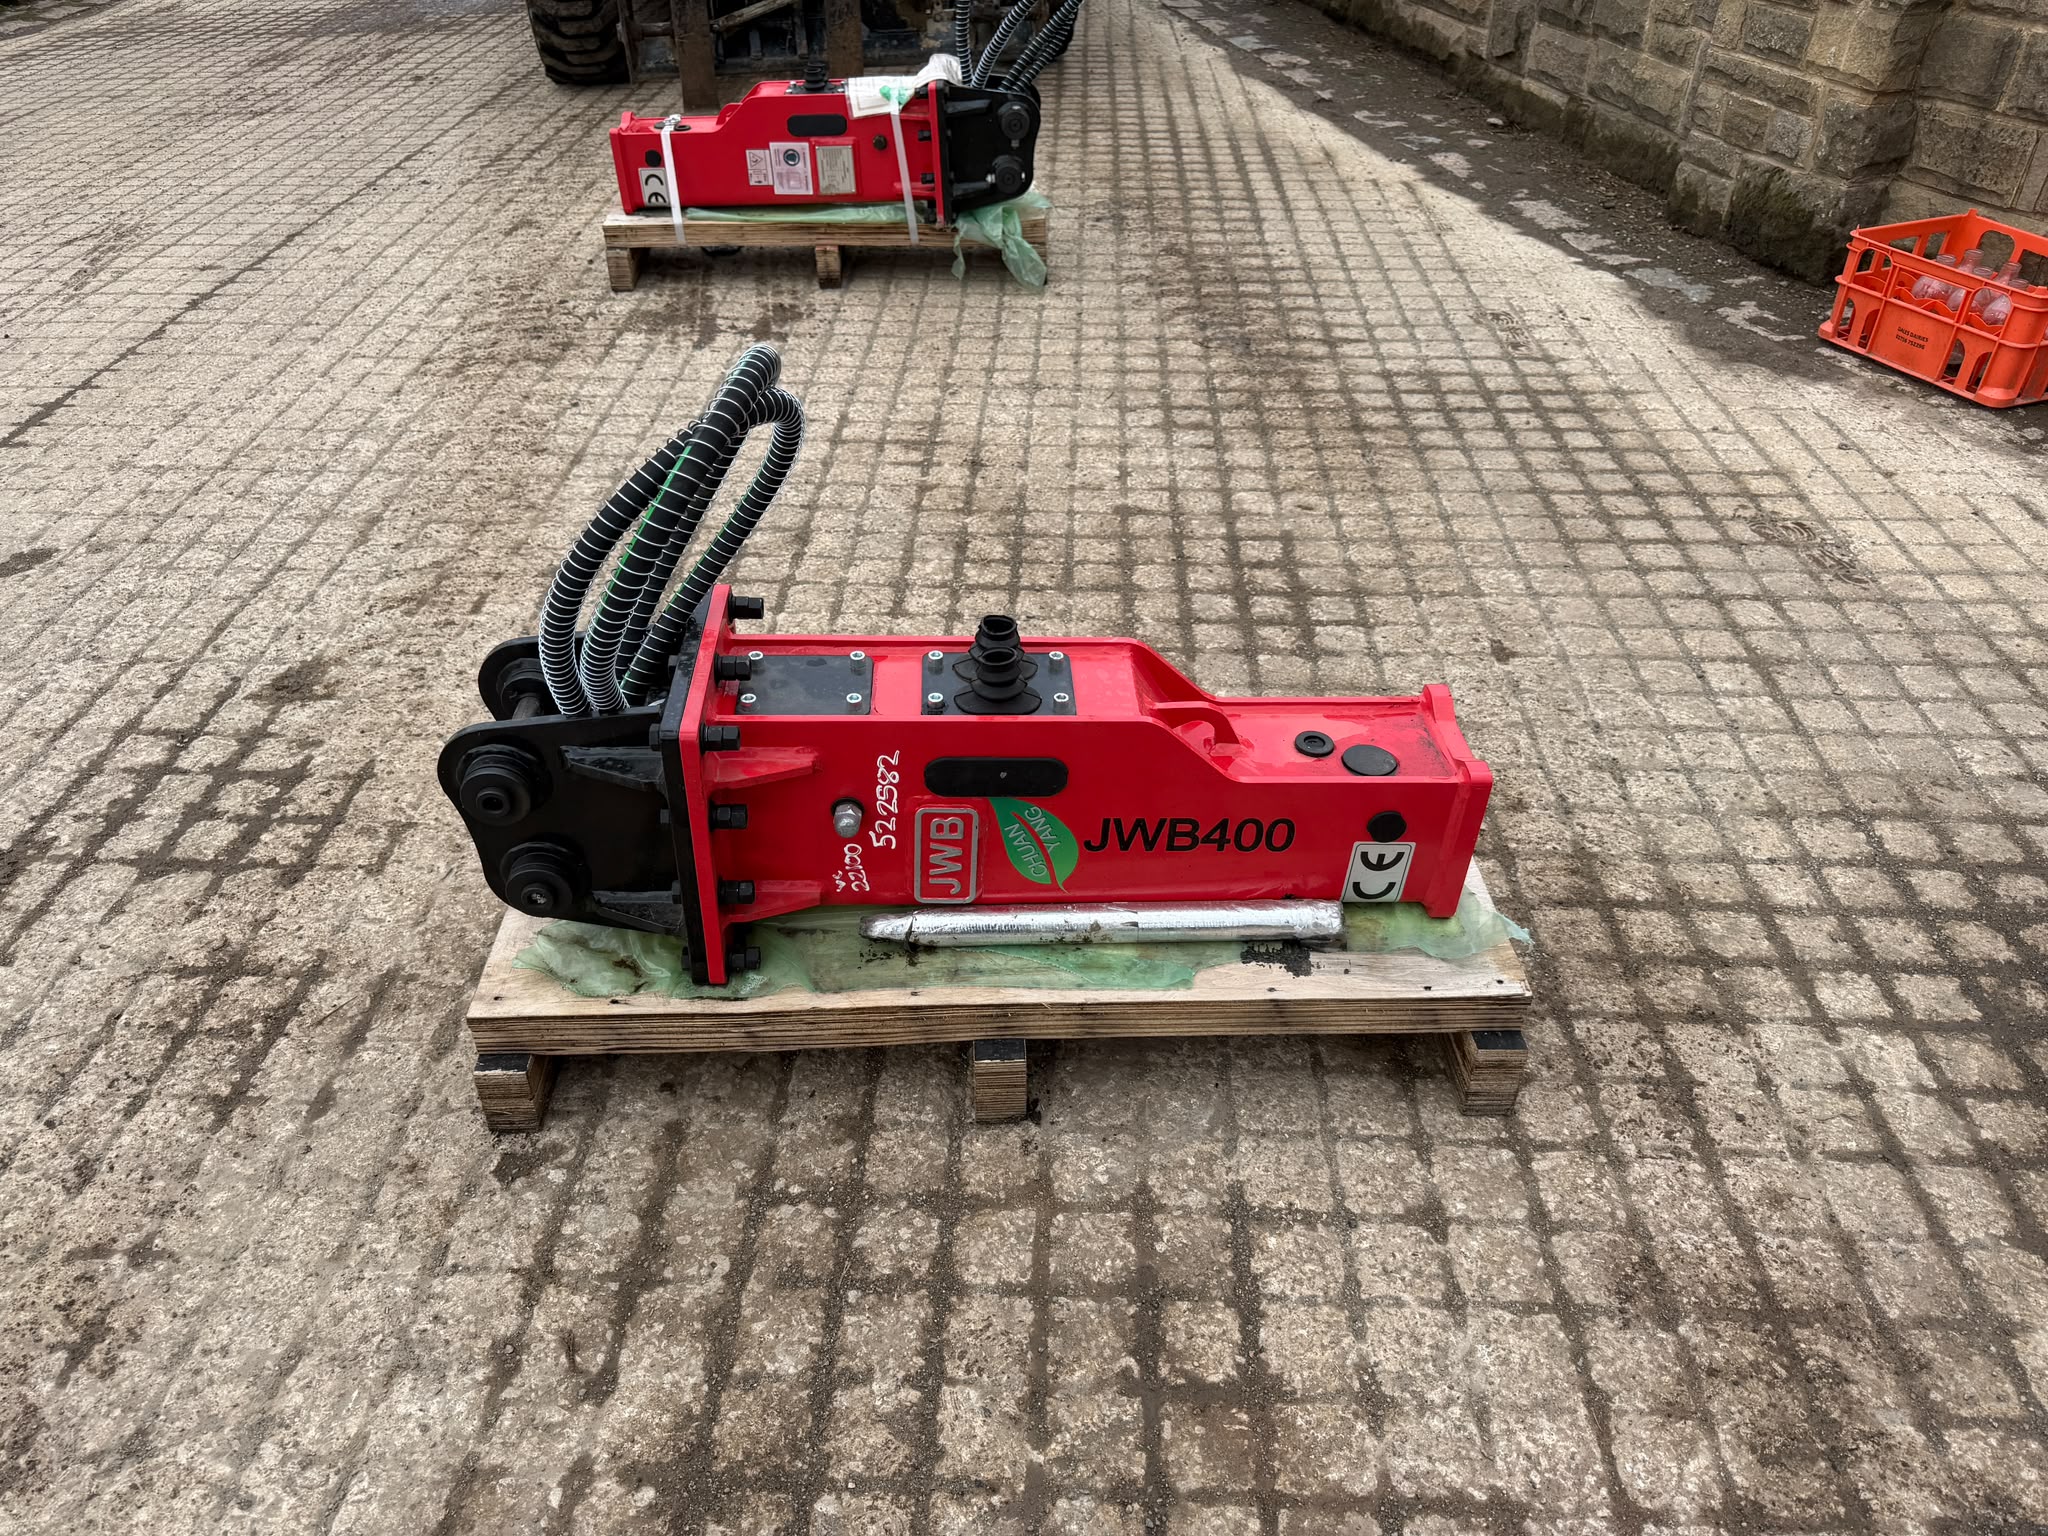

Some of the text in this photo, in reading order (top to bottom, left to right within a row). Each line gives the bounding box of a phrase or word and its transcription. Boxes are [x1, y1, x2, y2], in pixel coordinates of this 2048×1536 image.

[1004, 823, 1048, 877] CHUAN
[1024, 806, 1061, 853] YANG
[1083, 817, 1296, 853] JWB400
[928, 816, 965, 895] JWB
[1352, 851, 1405, 900] CE
